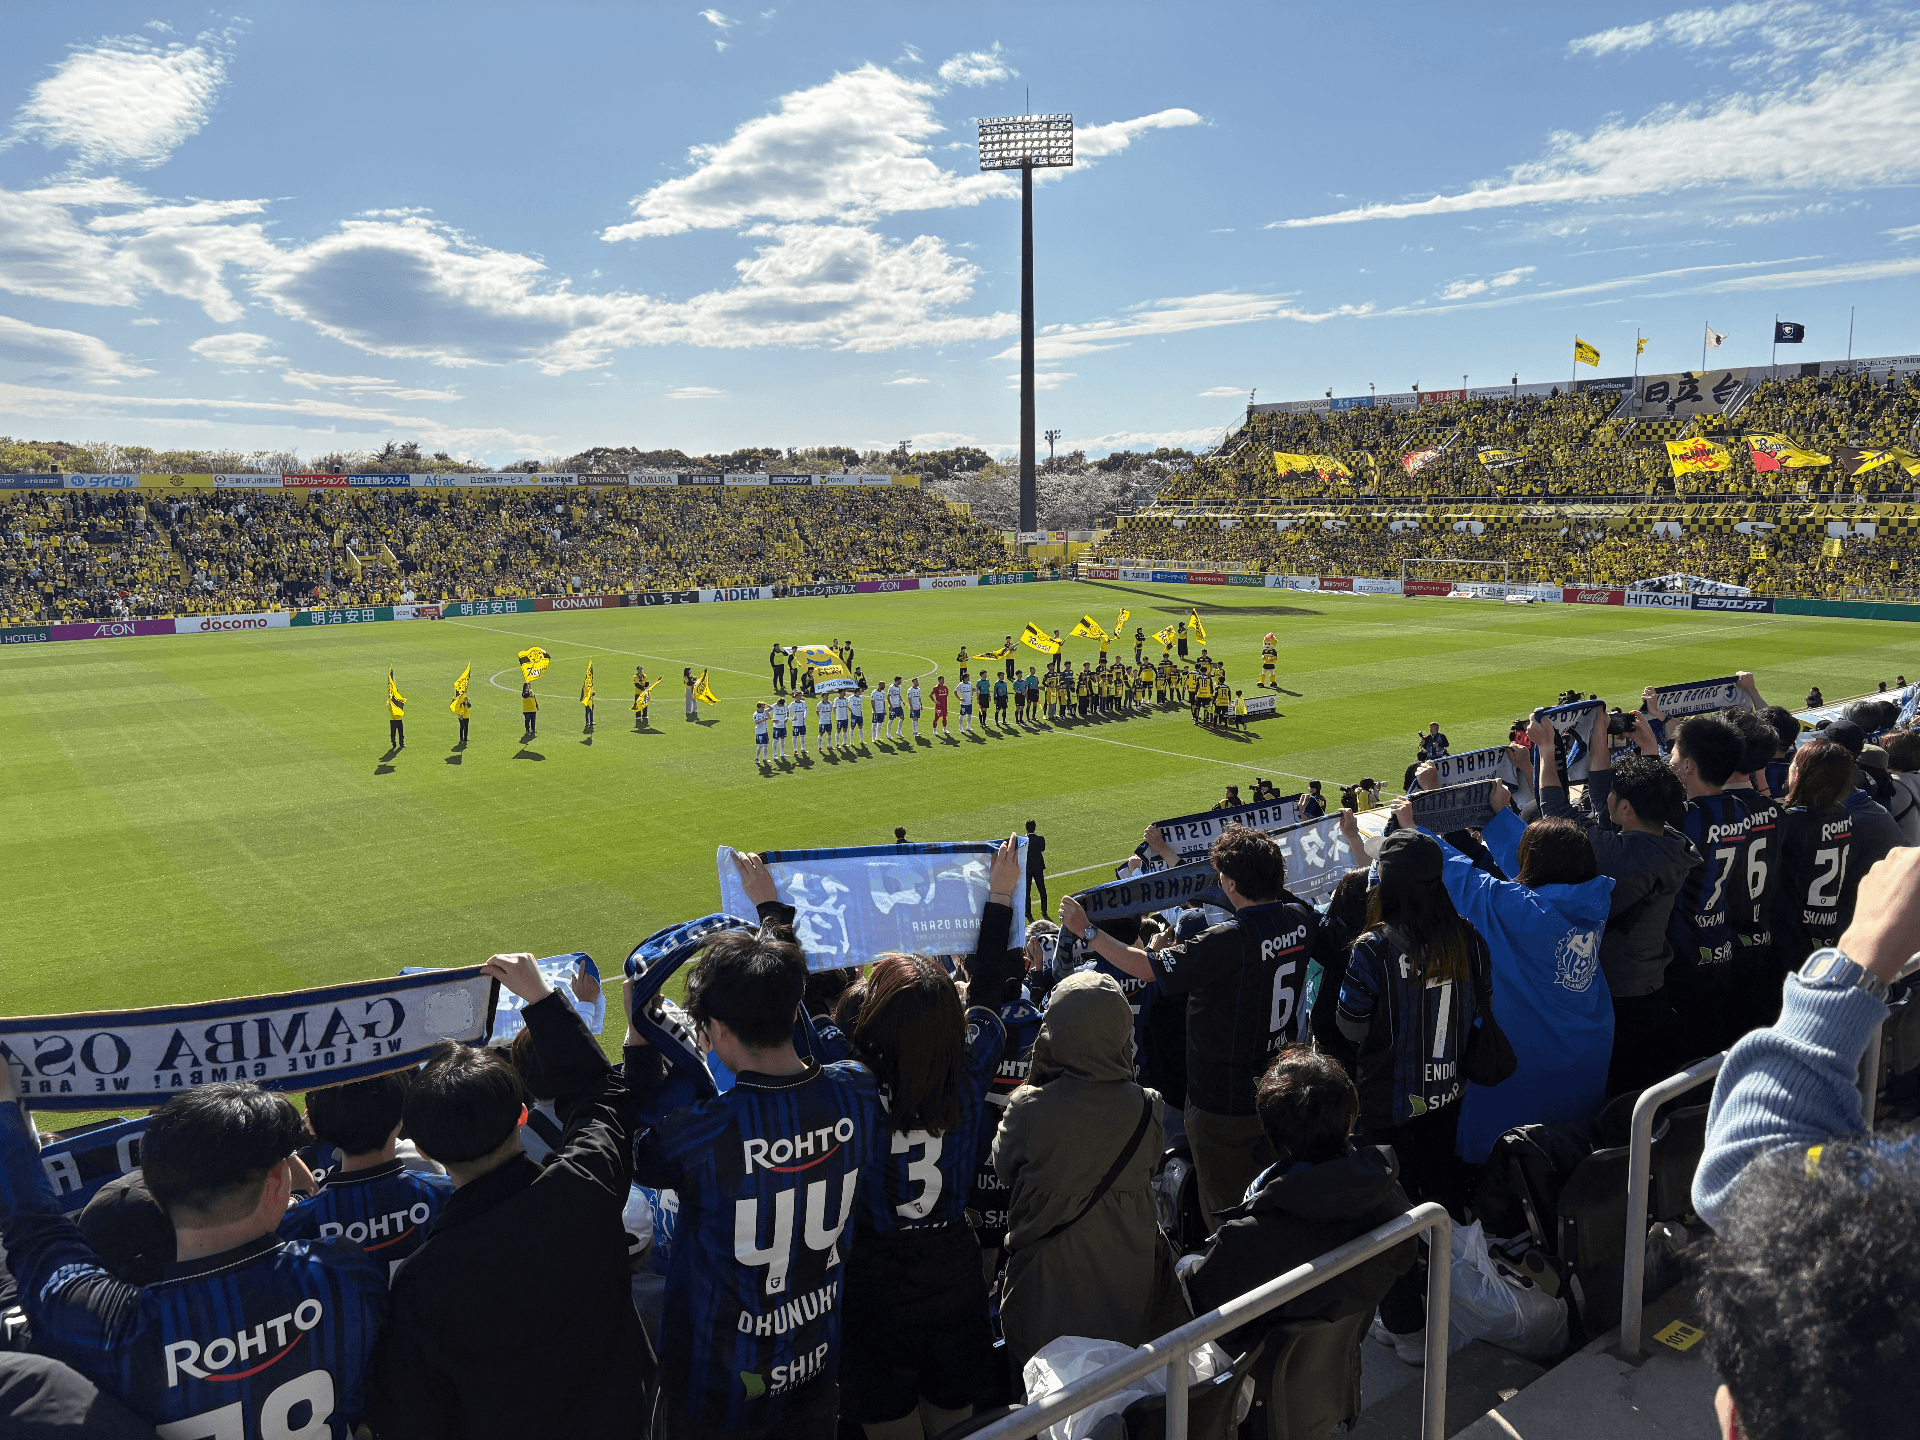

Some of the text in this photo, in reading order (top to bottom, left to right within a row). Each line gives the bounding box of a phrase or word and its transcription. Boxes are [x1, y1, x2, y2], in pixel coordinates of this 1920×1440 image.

[89, 475, 134, 488] ダイビル
[284, 475, 347, 485] 日立ソリューションズ
[349, 475, 410, 485] 日立産機システム
[424, 475, 456, 487] Aflac
[633, 476, 673, 484] NOMURA
[988, 573, 1024, 585] 明治安田
[1087, 569, 1118, 580] HITACHI
[931, 578, 967, 589] docomo
[1273, 576, 1300, 589] Aflac
[643, 591, 691, 606] いちご
[714, 587, 760, 602] AiDEM
[1627, 592, 1689, 607] HITACHI
[461, 601, 518, 616] 明治安田
[552, 597, 603, 611] KONAMI
[200, 617, 267, 631] docomo
[311, 608, 375, 625] 明治安田
[5, 633, 47, 644] HOTELS
[1706, 817, 1752, 843] ROHTO
[1748, 837, 1767, 900] 6
[1704, 847, 1736, 911] 7
[1260, 925, 1306, 961] ROHTO
[1269, 961, 1296, 1033] 6
[1425, 977, 1452, 1058] 7
[1424, 1060, 1455, 1082] ENDO
[744, 1117, 854, 1175] ROHTO
[891, 1129, 945, 1219] 3
[319, 1202, 430, 1244] ROHTO
[734, 1167, 859, 1296] 44
[165, 1298, 323, 1388] ROHTO
[770, 1342, 829, 1390] SHIP
